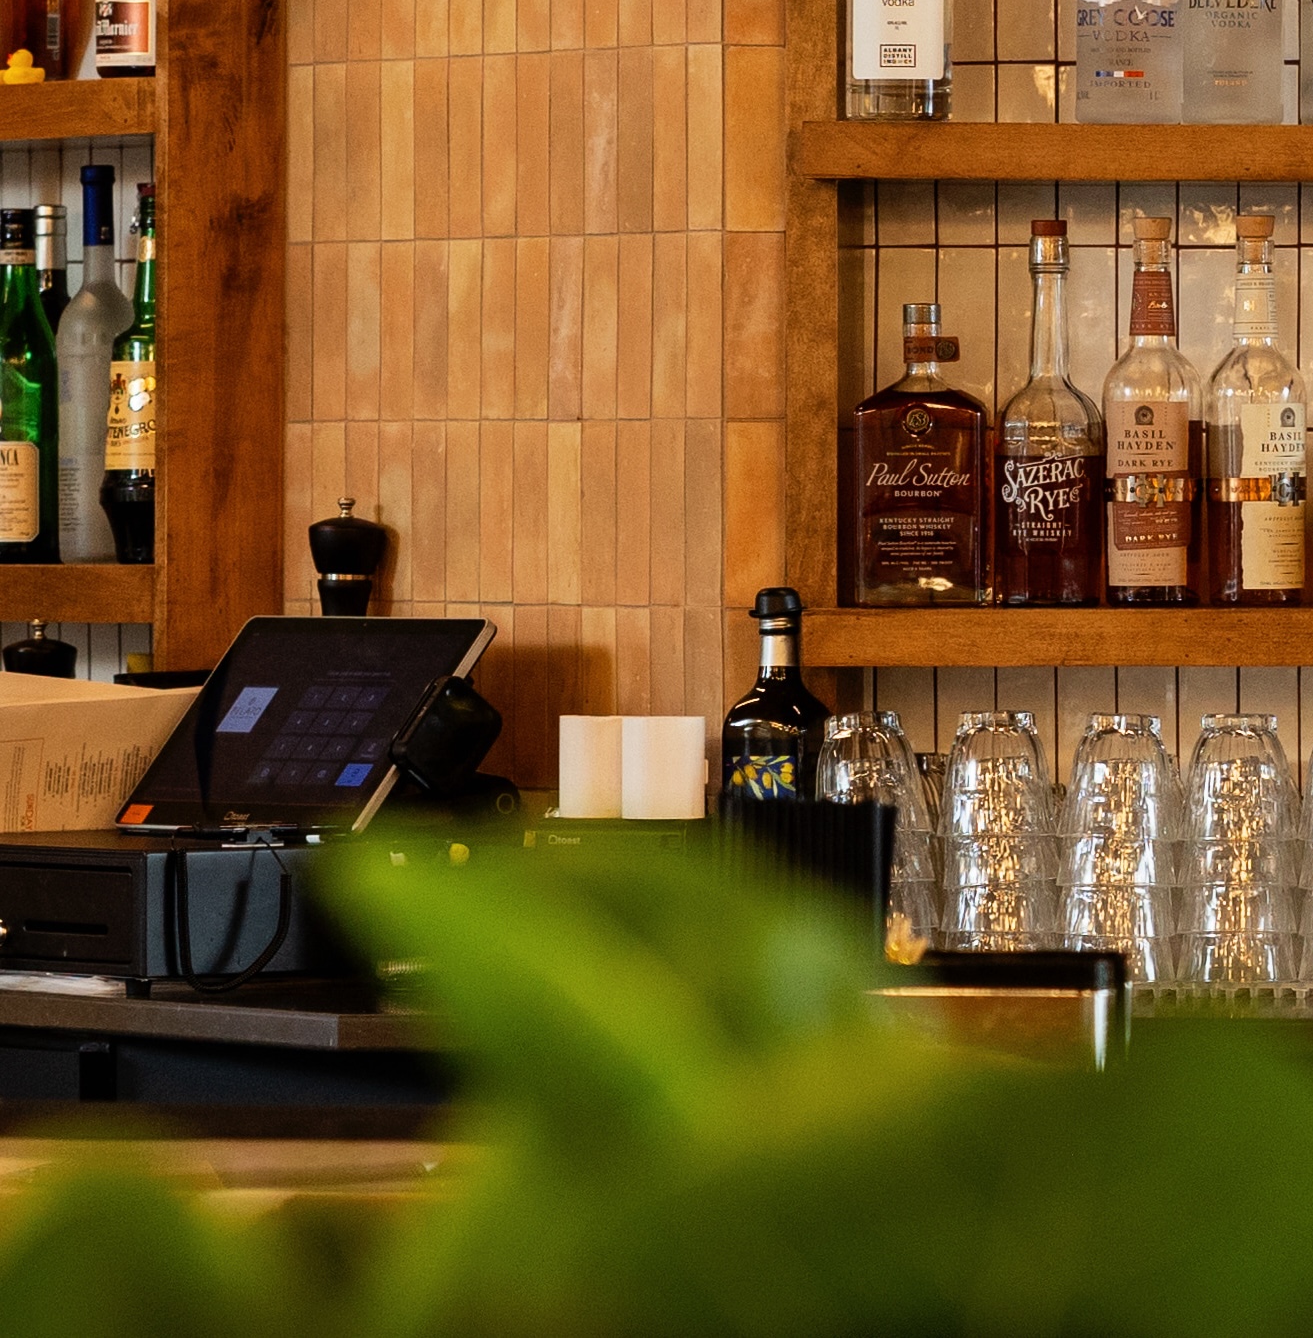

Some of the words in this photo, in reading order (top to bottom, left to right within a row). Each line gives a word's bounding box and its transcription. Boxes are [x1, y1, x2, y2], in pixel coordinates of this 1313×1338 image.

[1076, 8, 1104, 27] GREY
[1205, 11, 1258, 20] ORGANIC
[1211, 20, 1251, 29] VODKA
[1093, 30, 1151, 42] VODKA
[1124, 429, 1166, 439] BASIL
[1269, 431, 1302, 441] BASIL
[1117, 441, 1174, 451] HAYDEN
[1117, 460, 1147, 468] DARK
[1152, 460, 1174, 468] RYE
[866, 458, 918, 487] Paul
[912, 462, 971, 488] Sutton
[1001, 458, 1085, 503] SAZERAC
[1023, 486, 1070, 521] RYE
[1125, 534, 1156, 543] DARK
[1158, 533, 1178, 541] RYE
